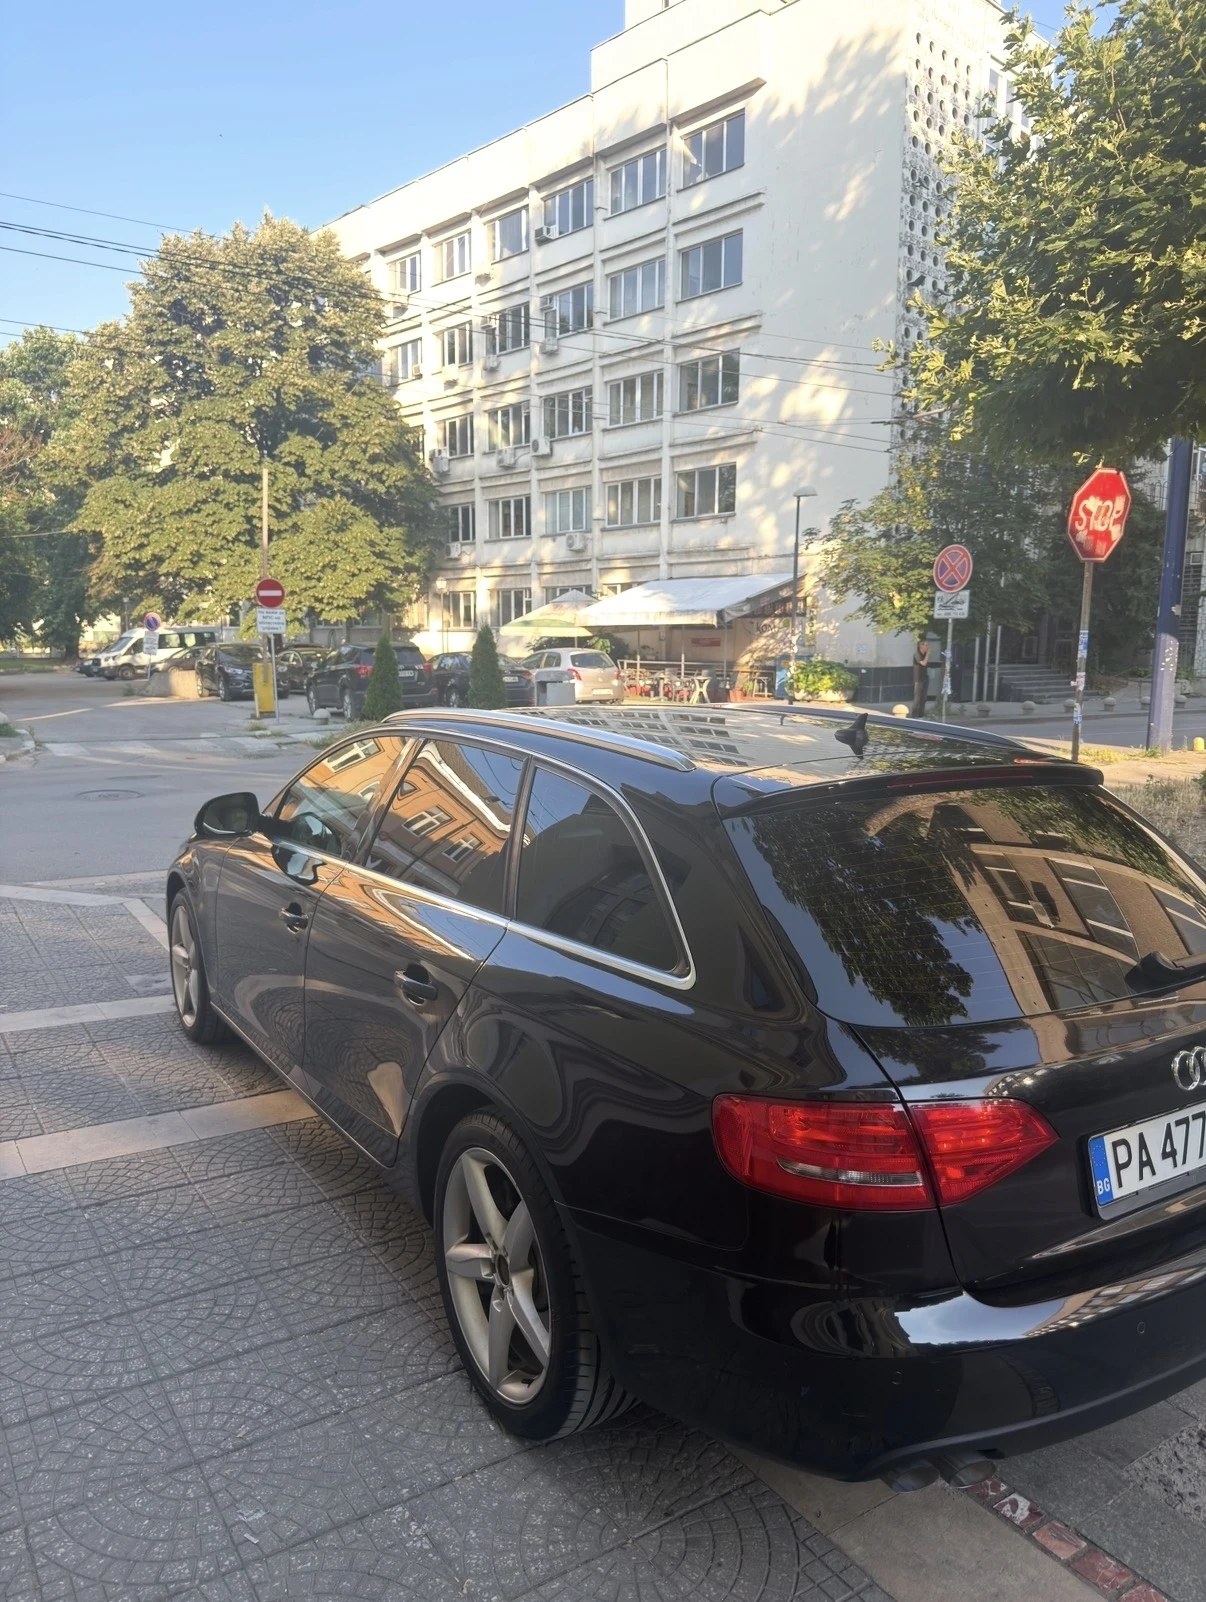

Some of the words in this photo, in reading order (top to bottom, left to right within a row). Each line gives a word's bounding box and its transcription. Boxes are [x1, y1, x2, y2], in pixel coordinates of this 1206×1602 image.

[1075, 497, 1124, 531] STOP
[1111, 1131, 1157, 1189] PA
[1097, 1178, 1110, 1195] BG
